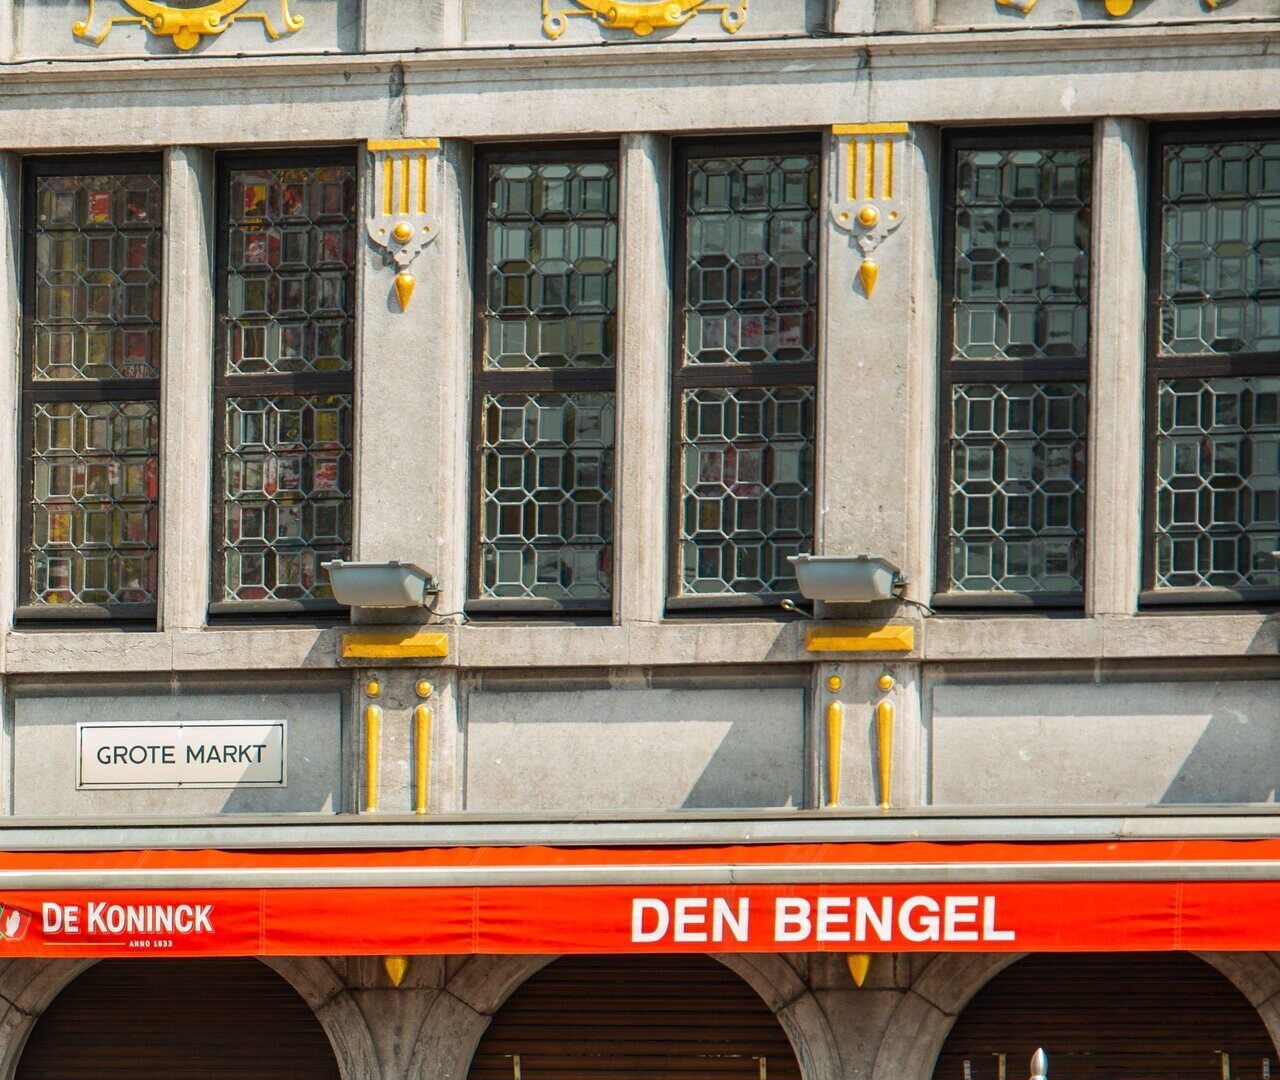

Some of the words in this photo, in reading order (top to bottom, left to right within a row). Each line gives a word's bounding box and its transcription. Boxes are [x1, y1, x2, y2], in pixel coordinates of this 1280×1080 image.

[97, 745, 175, 764] GROTE
[187, 744, 267, 764] MARKT
[42, 901, 80, 934] DE
[87, 901, 215, 935] KONINCK
[631, 897, 749, 943] DEN
[774, 895, 1016, 943] BENGEL
[129, 940, 151, 948] ANNO
